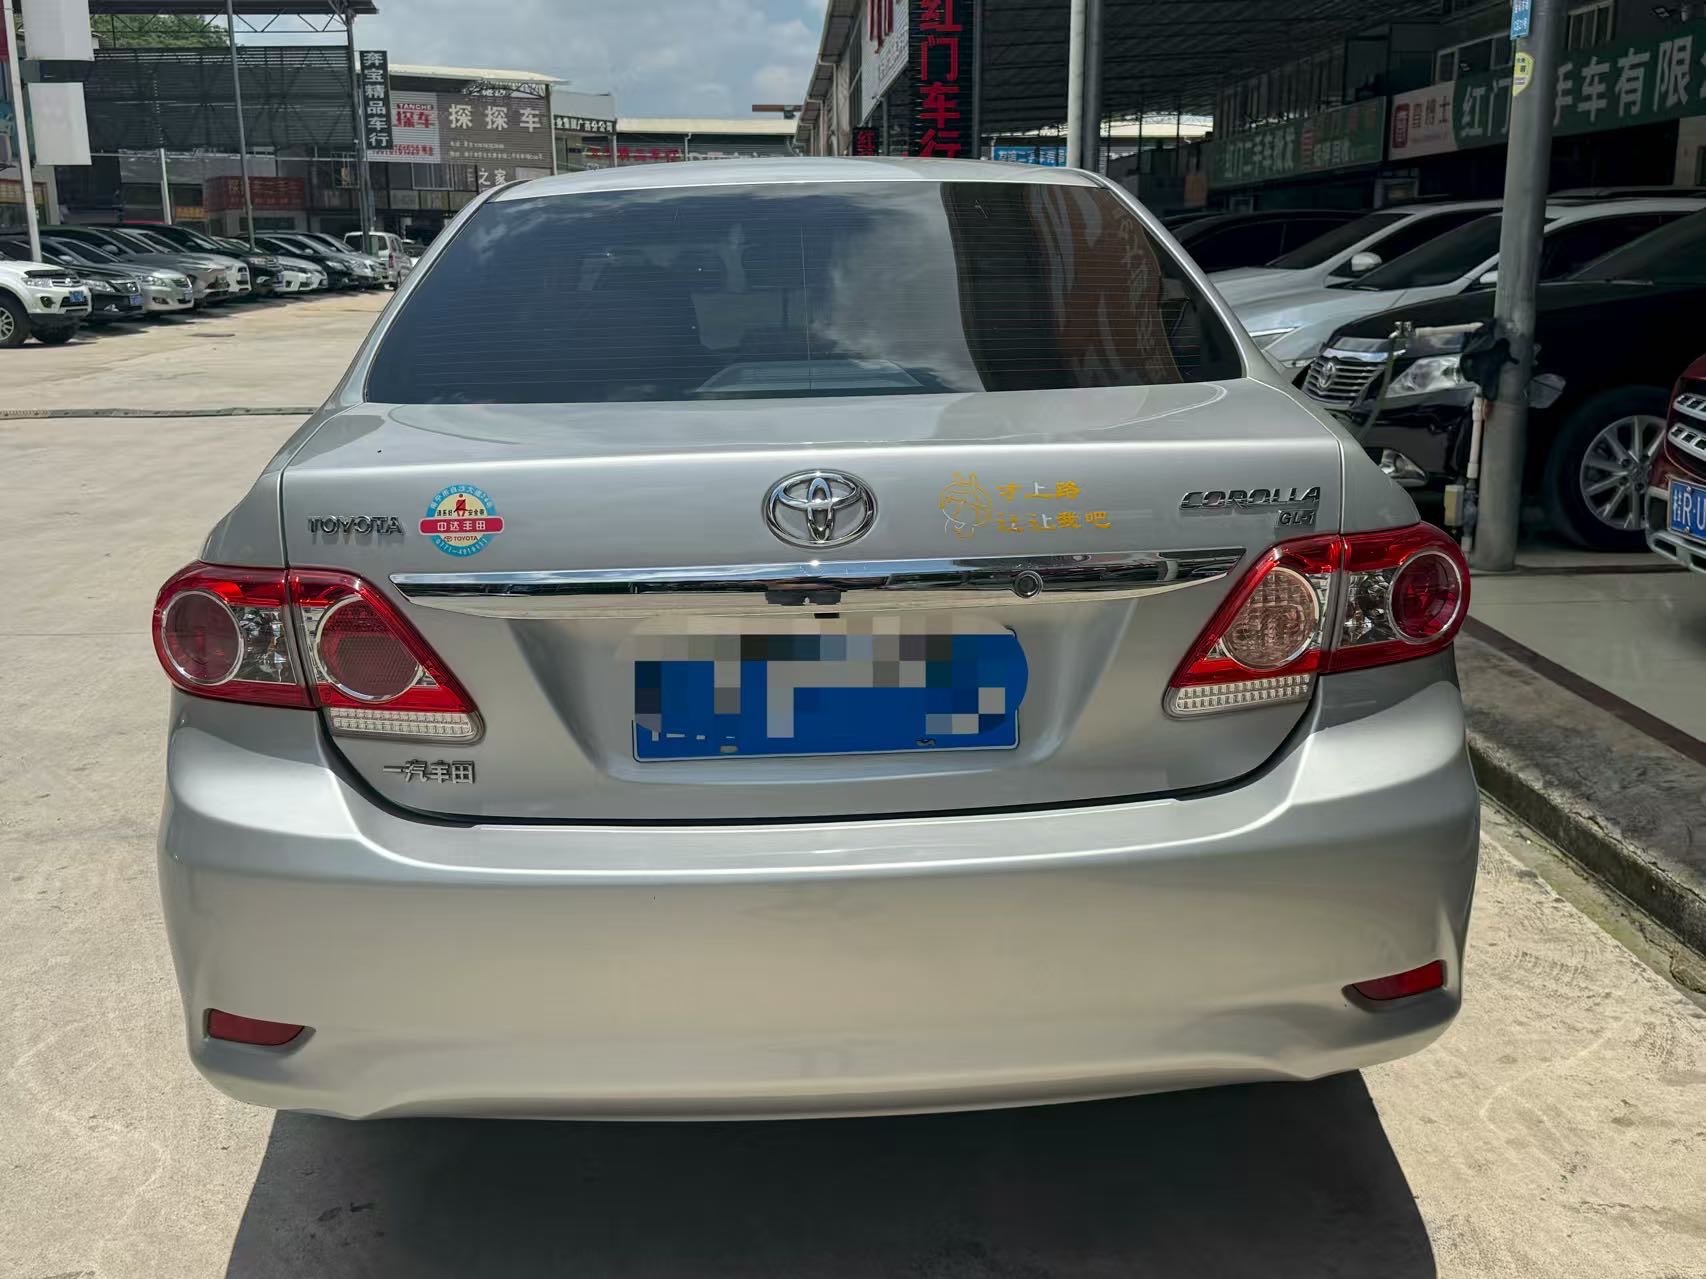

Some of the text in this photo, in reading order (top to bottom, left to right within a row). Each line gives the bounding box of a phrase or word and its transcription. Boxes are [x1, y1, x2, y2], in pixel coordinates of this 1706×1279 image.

[919, 0, 962, 158] 红门车行
[363, 53, 390, 147] 奔宝精品车行
[449, 104, 541, 132] 探探车
[996, 480, 1081, 503] 才上路
[1180, 487, 1320, 509] COROLLA
[306, 515, 405, 535] TOYOTA
[437, 520, 486, 531] 中达丰田
[383, 759, 474, 784] 一汽丰田
